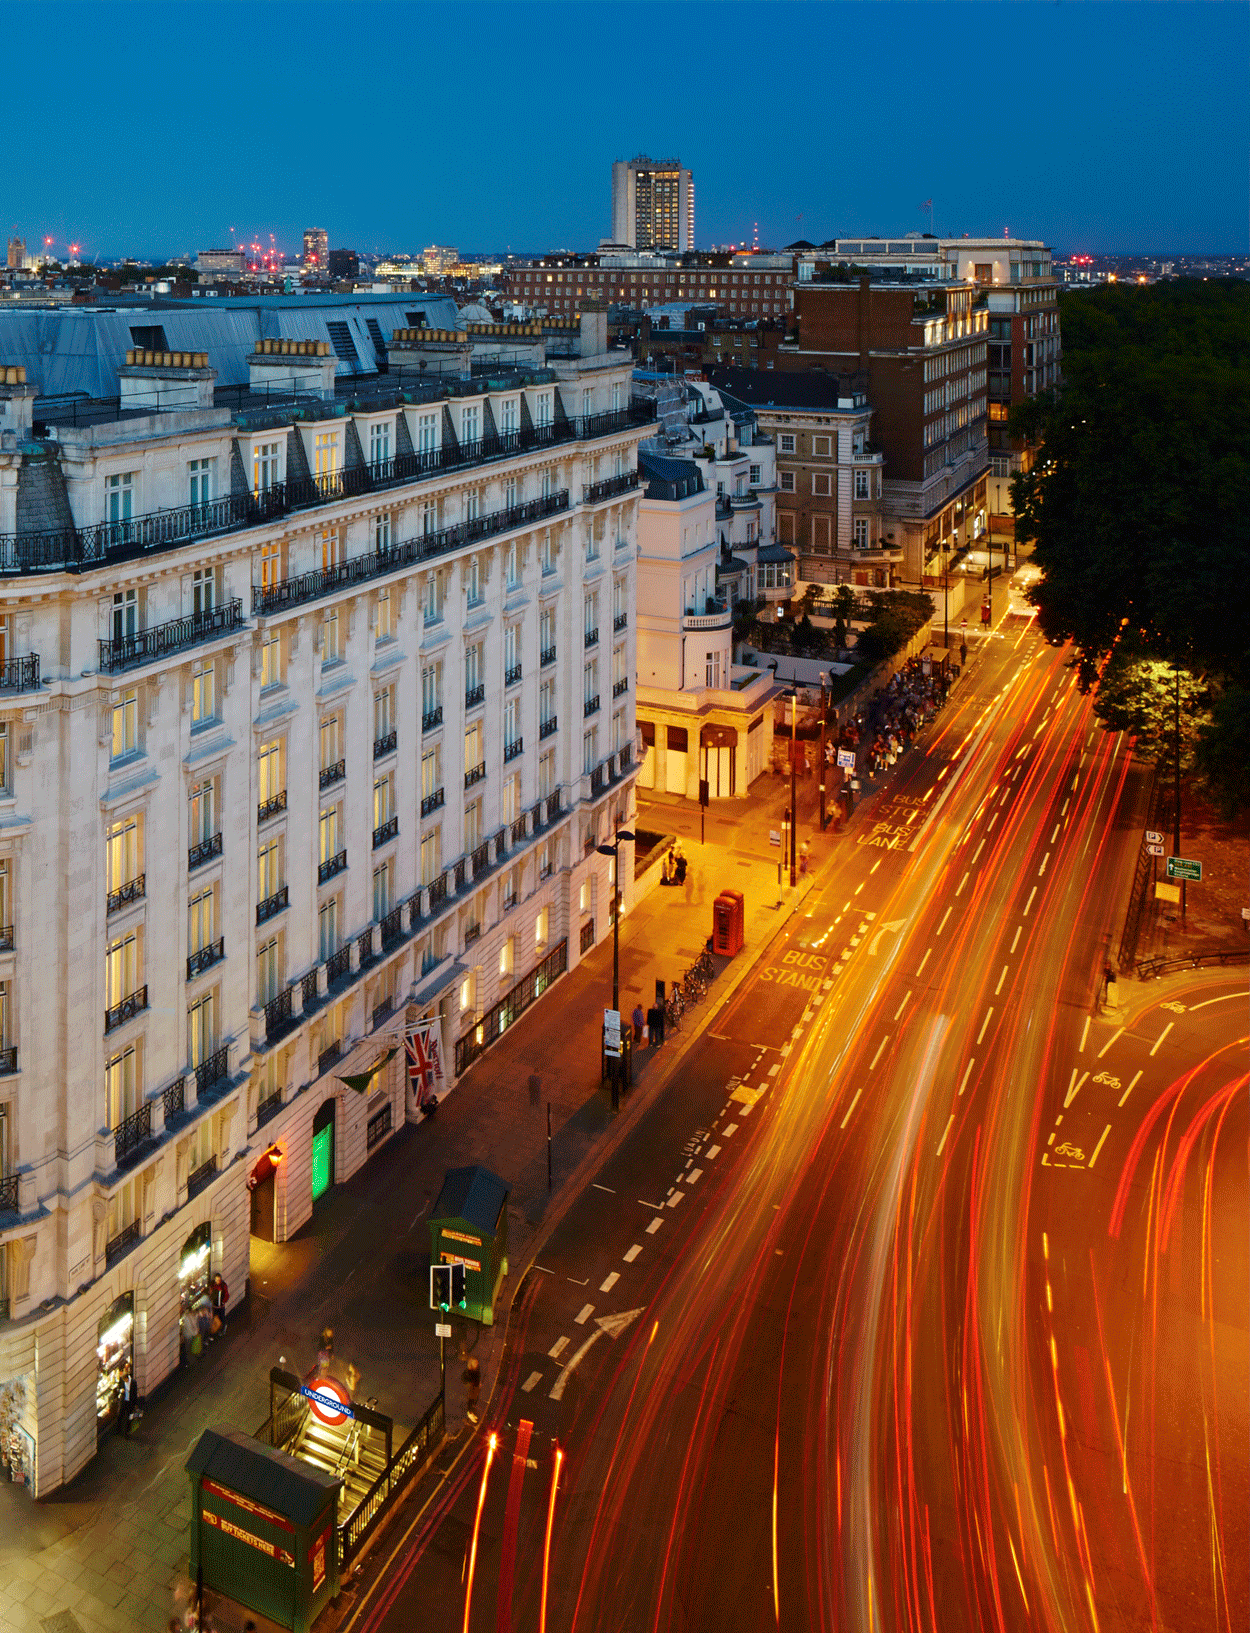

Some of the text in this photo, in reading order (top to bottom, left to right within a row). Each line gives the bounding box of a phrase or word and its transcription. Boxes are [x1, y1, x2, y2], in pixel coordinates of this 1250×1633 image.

[893, 794, 926, 807] BUS
[873, 822, 911, 837] BUS
[857, 834, 907, 851] LANE
[782, 950, 828, 970] BUS
[760, 967, 822, 993] STAND
[304, 1388, 352, 1415] UNDERGROUND
